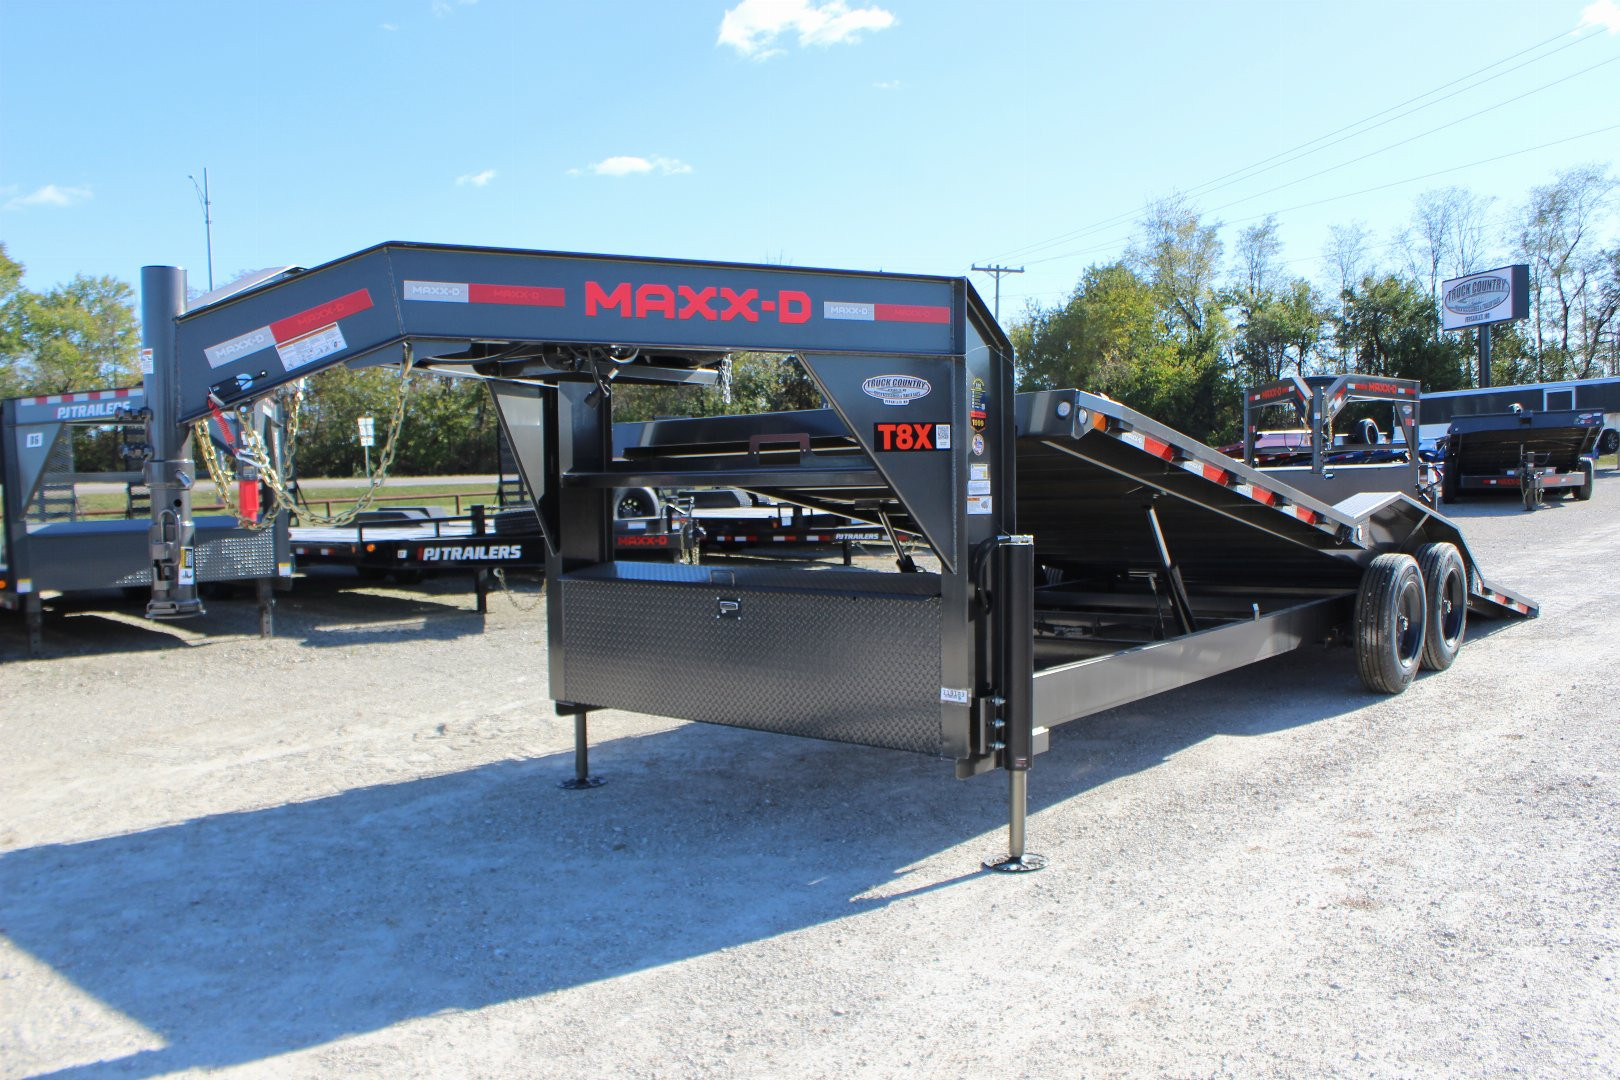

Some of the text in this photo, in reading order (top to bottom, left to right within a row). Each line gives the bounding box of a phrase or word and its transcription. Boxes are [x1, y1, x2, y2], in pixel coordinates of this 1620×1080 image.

[411, 286, 460, 297] MAXX-D
[1448, 279, 1507, 302] TRUCK COUNTRY
[585, 281, 811, 324] MAXX-D
[830, 306, 868, 315] MAXX-D
[215, 333, 265, 359] MAXX-D
[867, 378, 926, 388] TRUCK COUNTRY
[877, 424, 933, 450] T8X
[617, 535, 669, 546] MAXX-D
